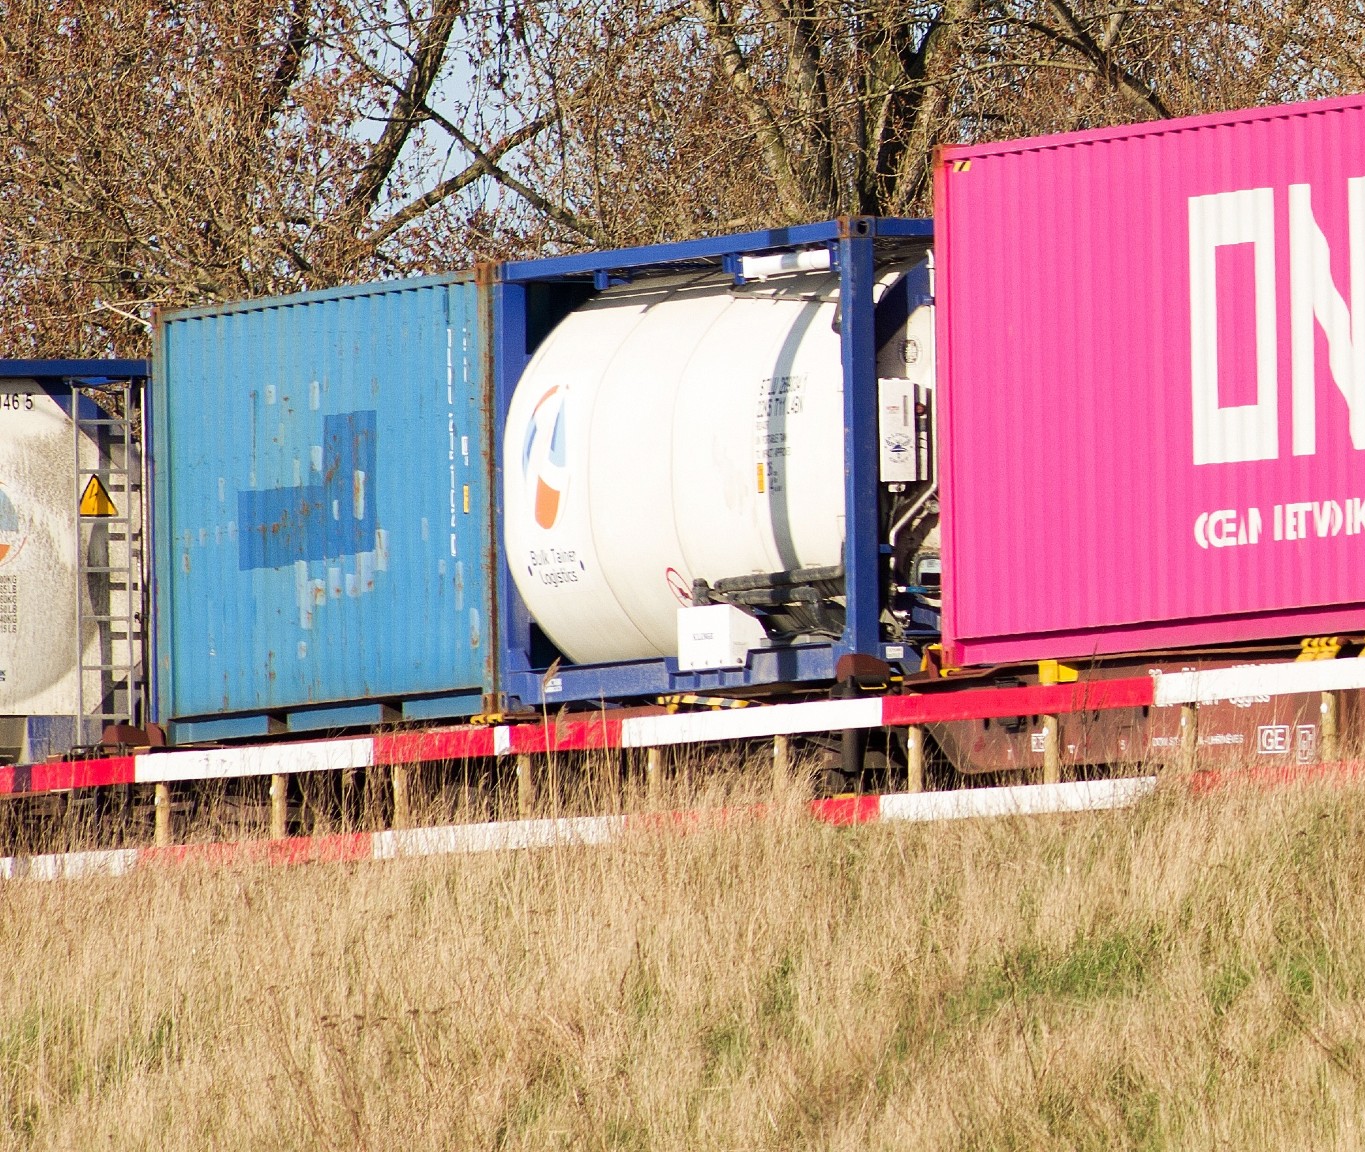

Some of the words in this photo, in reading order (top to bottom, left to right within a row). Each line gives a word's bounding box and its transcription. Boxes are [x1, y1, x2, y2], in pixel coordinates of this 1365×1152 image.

[0, 393, 20, 410] 46
[25, 393, 34, 410] 5
[1262, 729, 1286, 751] GE
